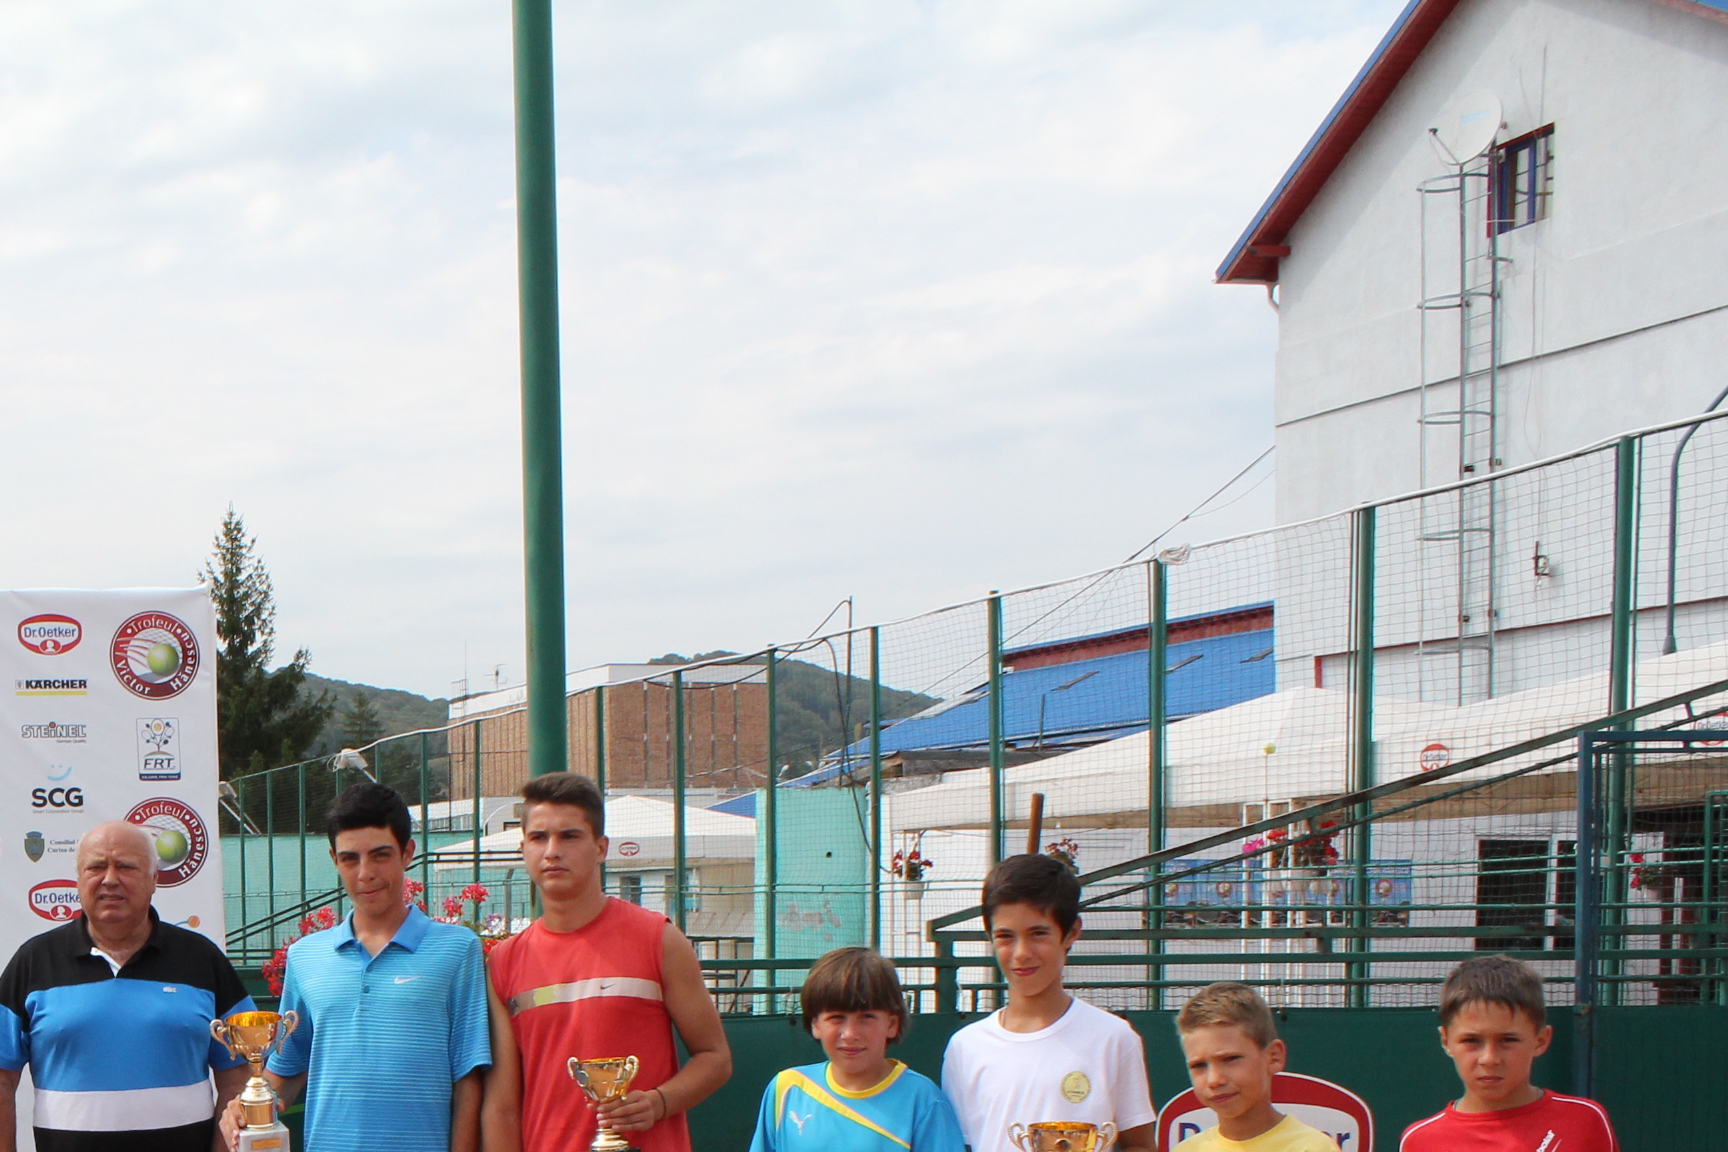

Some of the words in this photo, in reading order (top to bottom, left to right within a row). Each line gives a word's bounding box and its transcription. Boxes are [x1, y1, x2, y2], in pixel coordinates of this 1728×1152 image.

[130, 615, 176, 633] Trofeul
[116, 660, 151, 694] Victor
[144, 758, 174, 769] FRT
[32, 787, 84, 808] SCG
[138, 801, 186, 819] Trofeul
[35, 893, 81, 904] Dr.Oetke
